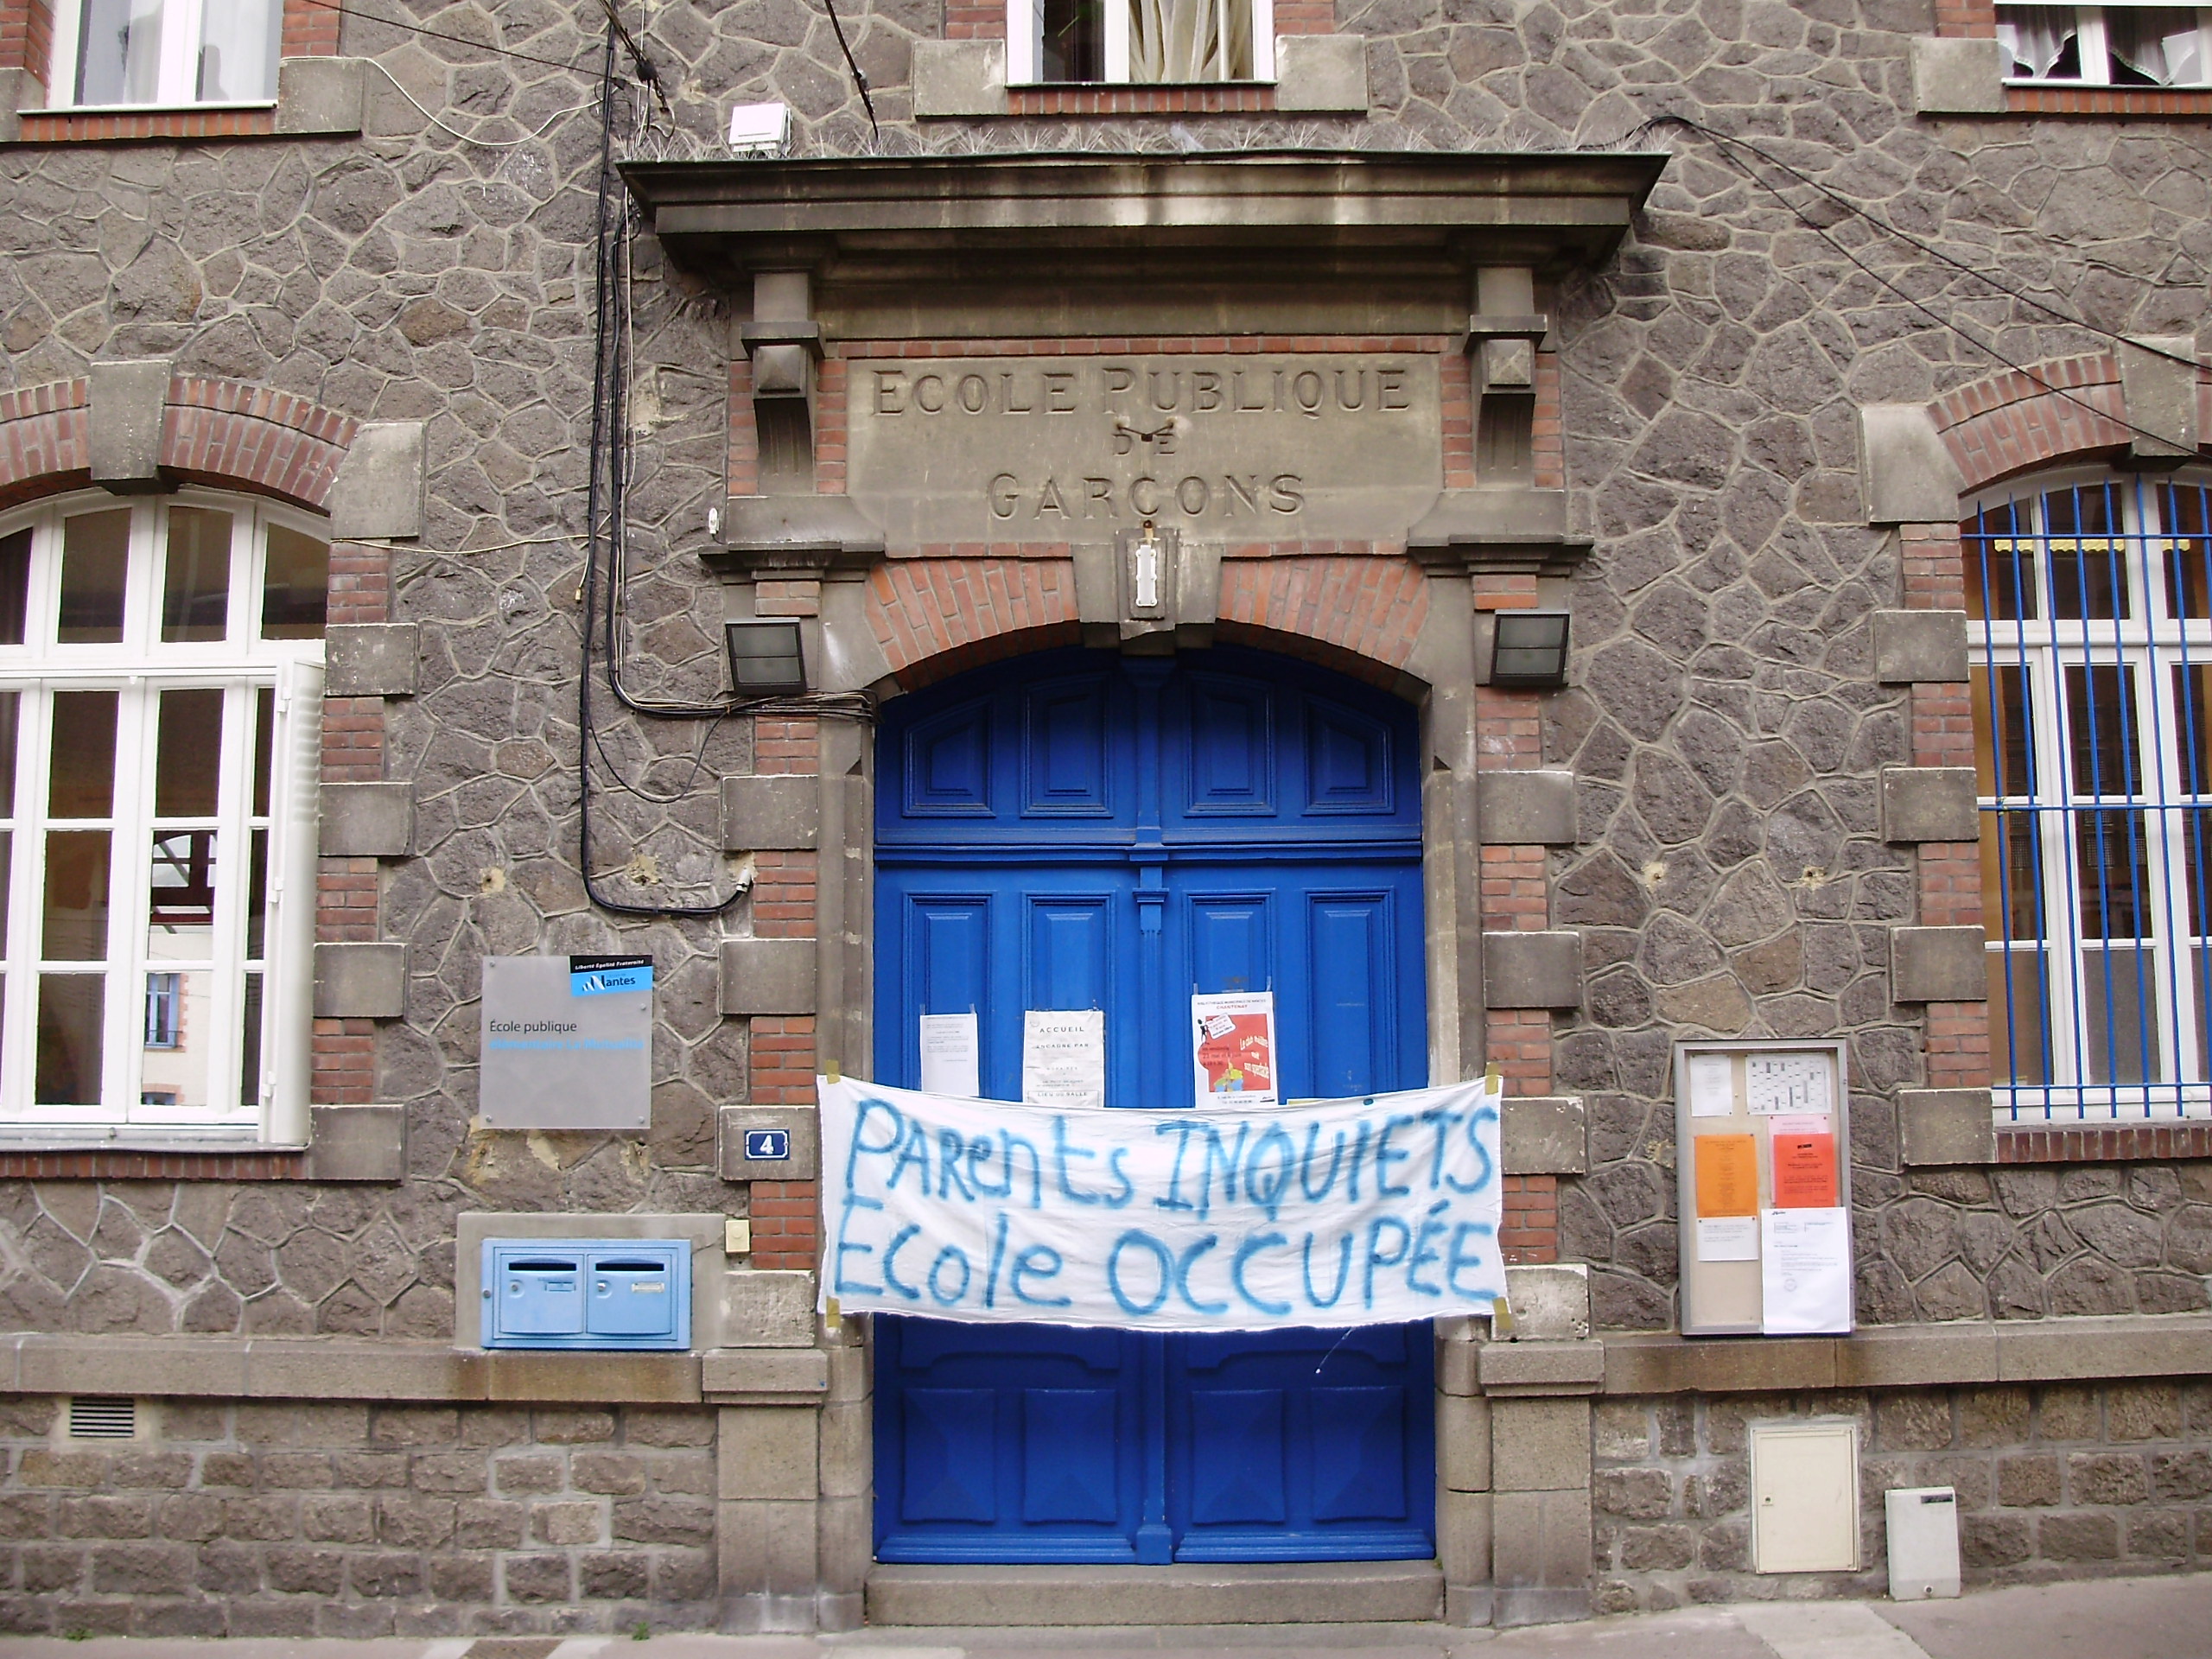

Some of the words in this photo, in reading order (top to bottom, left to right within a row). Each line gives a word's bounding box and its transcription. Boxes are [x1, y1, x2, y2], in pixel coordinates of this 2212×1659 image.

[869, 368, 1077, 417] ECOLE
[1101, 366, 1410, 421] PUBLIQUE
[1111, 433, 1176, 456] DE
[489, 1019, 521, 1033] École
[524, 1020, 578, 1034] publique
[760, 1135, 774, 1154] 4
[1154, 1105, 1499, 1222] INQUIETS
[1107, 1198, 1499, 1317] OCCUPÉE
